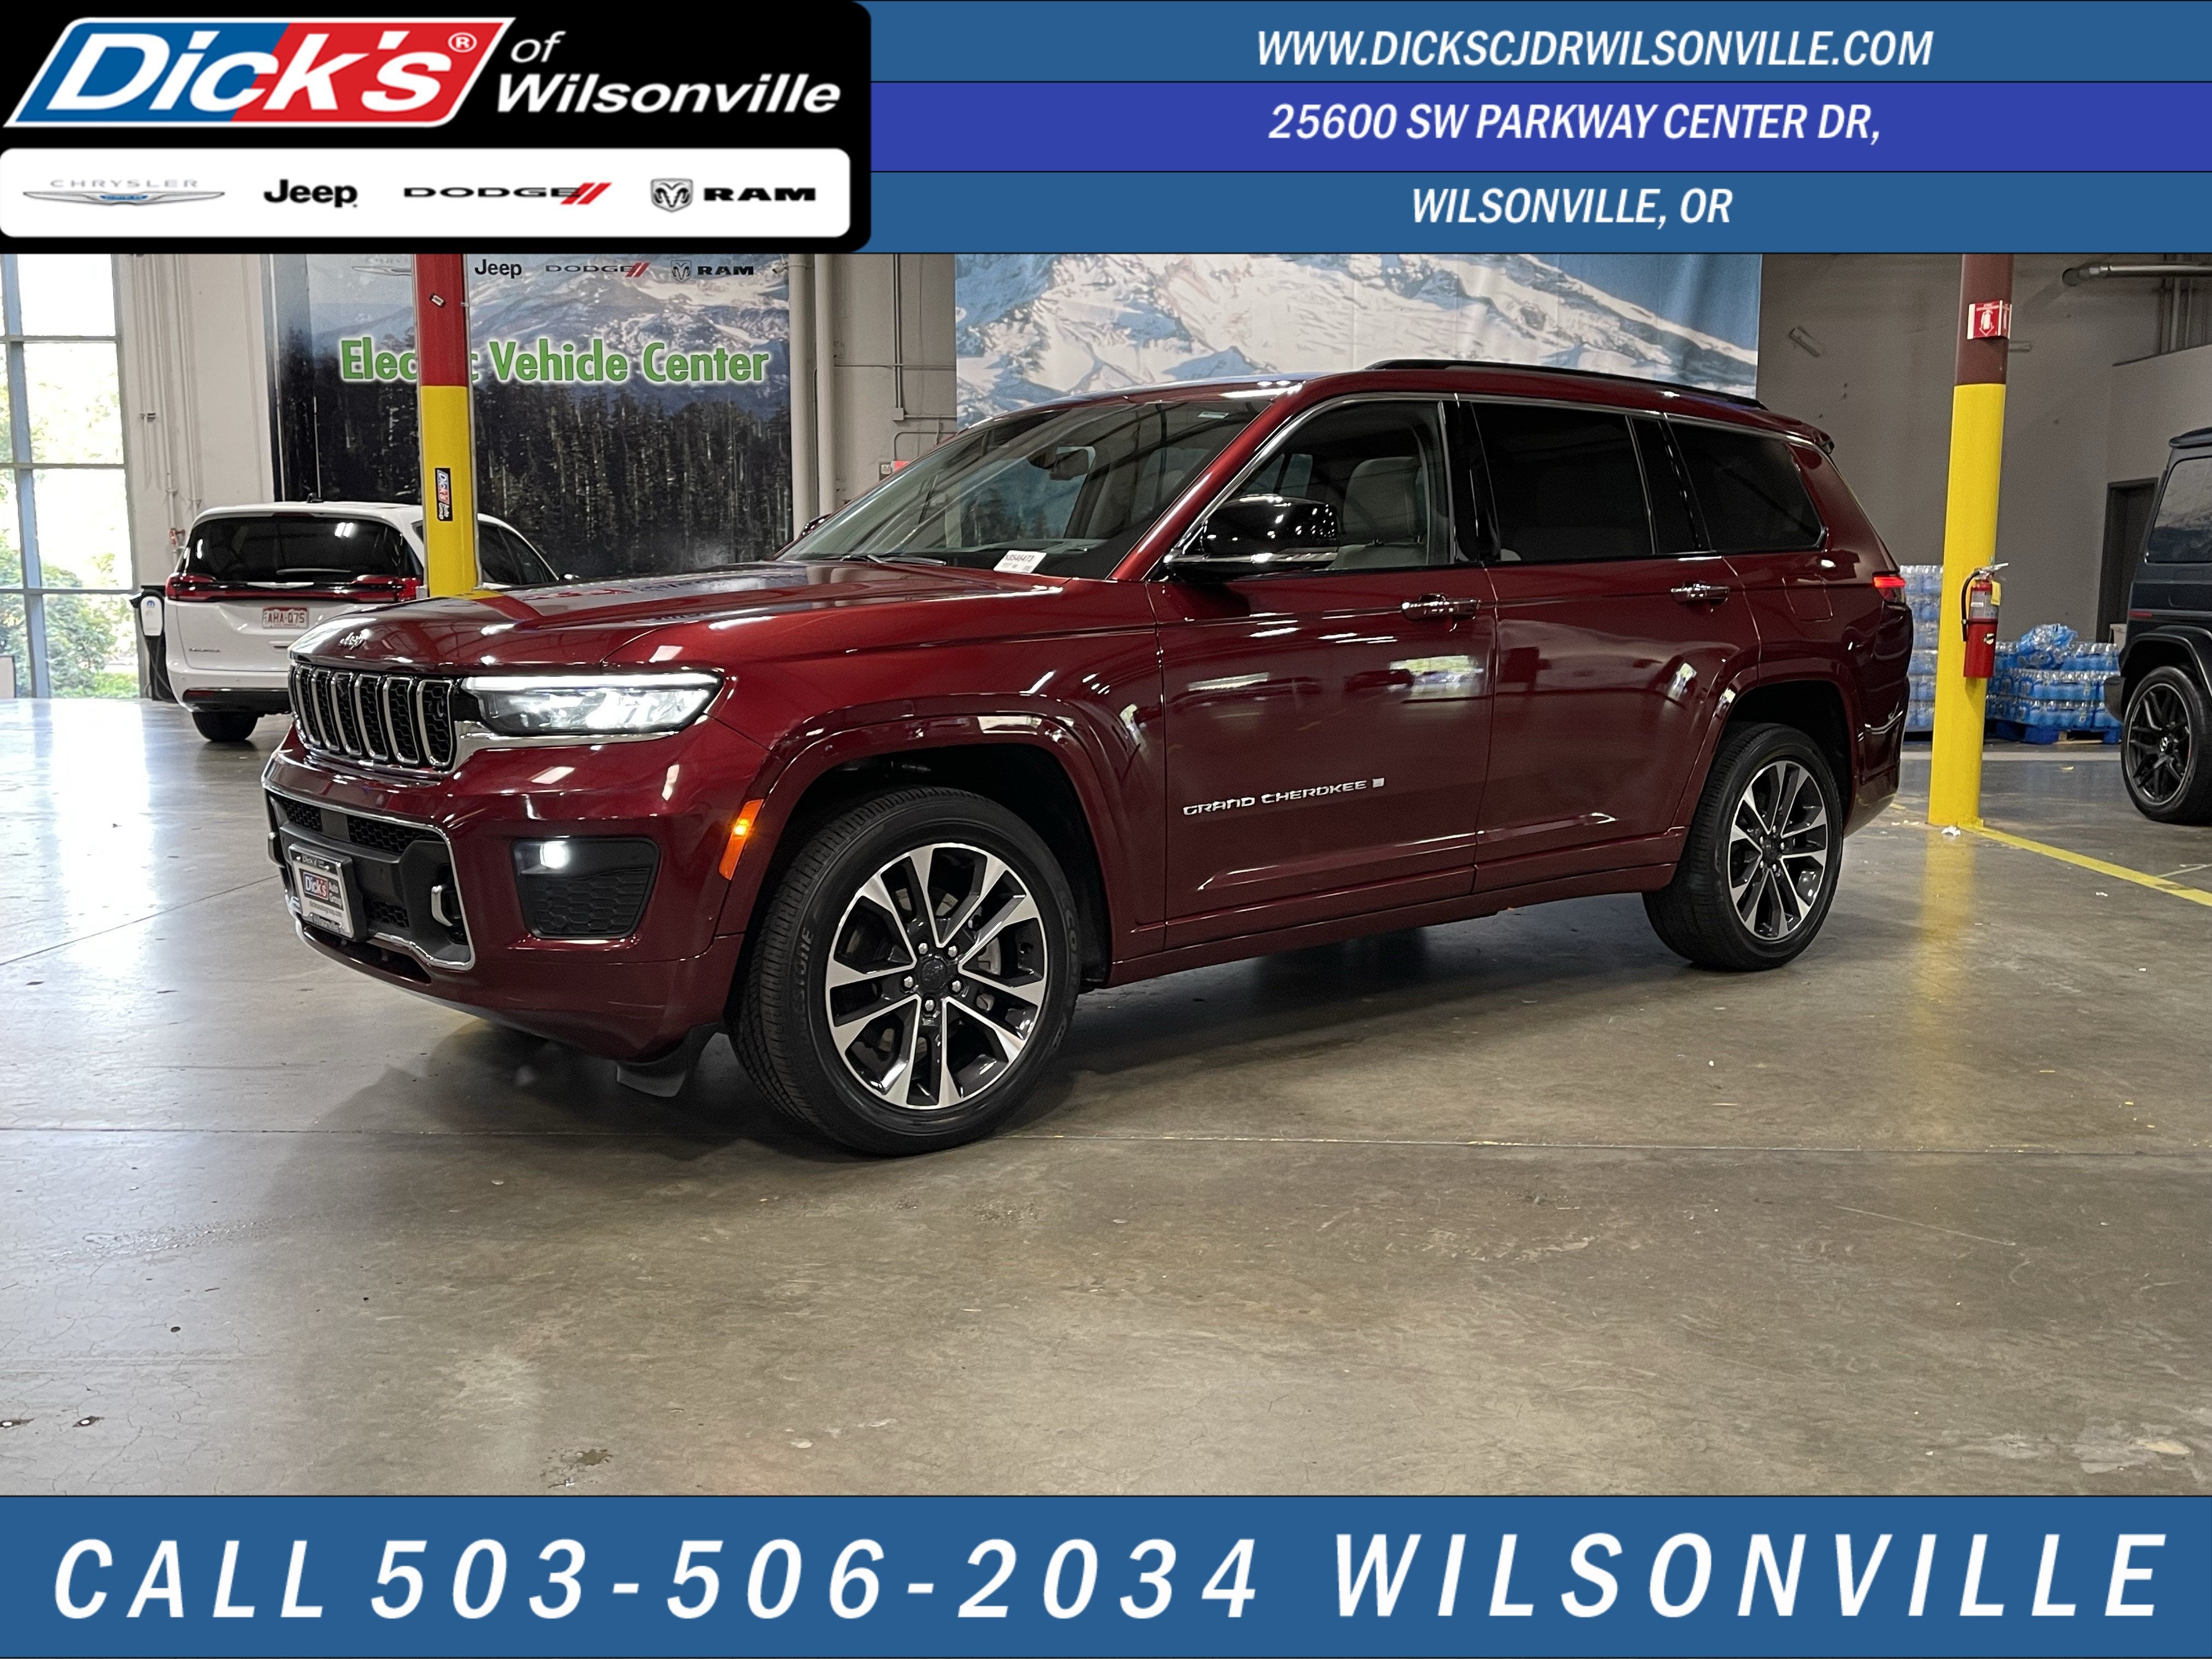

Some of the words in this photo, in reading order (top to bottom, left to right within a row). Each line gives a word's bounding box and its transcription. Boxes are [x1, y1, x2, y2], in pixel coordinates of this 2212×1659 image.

[475, 259, 522, 279] Jeep
[697, 266, 754, 275] RAM
[341, 337, 479, 381] Elec
[489, 338, 628, 382] Vehicle
[643, 342, 769, 382] Center
[1183, 796, 1256, 816] GRAND
[1261, 780, 1367, 804] CHEROKEE
